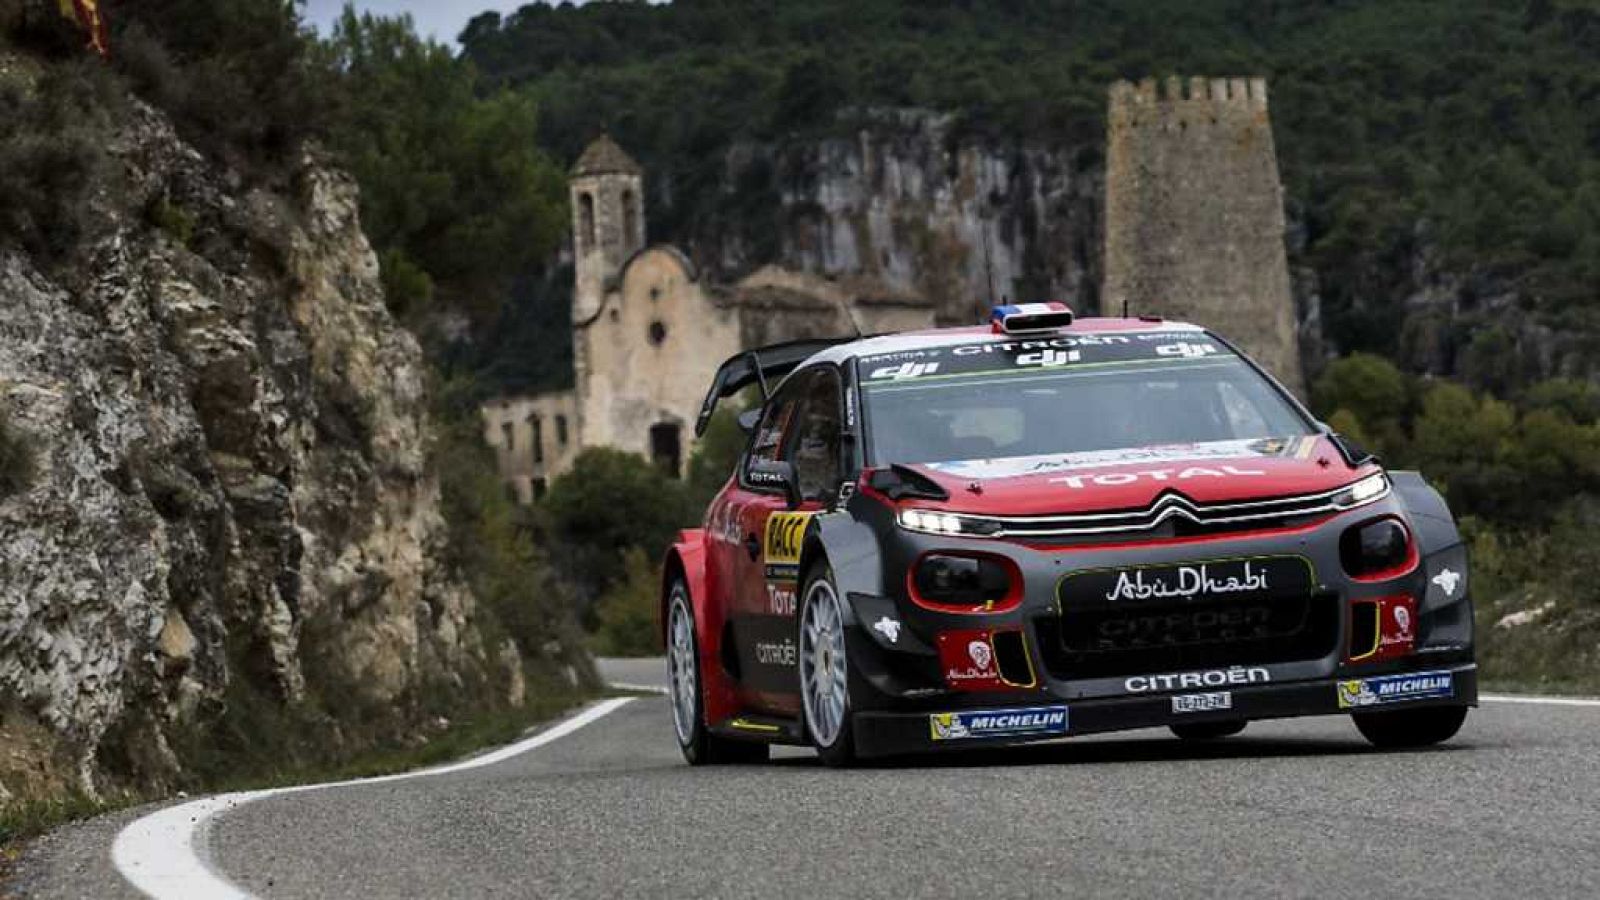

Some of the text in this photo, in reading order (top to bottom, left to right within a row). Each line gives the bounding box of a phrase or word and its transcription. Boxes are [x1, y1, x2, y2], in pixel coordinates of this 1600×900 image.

[750, 472, 784, 482] TOTAL
[1049, 465, 1266, 489] TOTAL
[768, 516, 804, 557] RACC
[767, 584, 797, 615] TOTA
[756, 639, 796, 665] CITROË
[1124, 665, 1270, 692] CITROËN
[1379, 677, 1451, 695] MICHELIN
[971, 711, 1065, 729] MICHELIN
